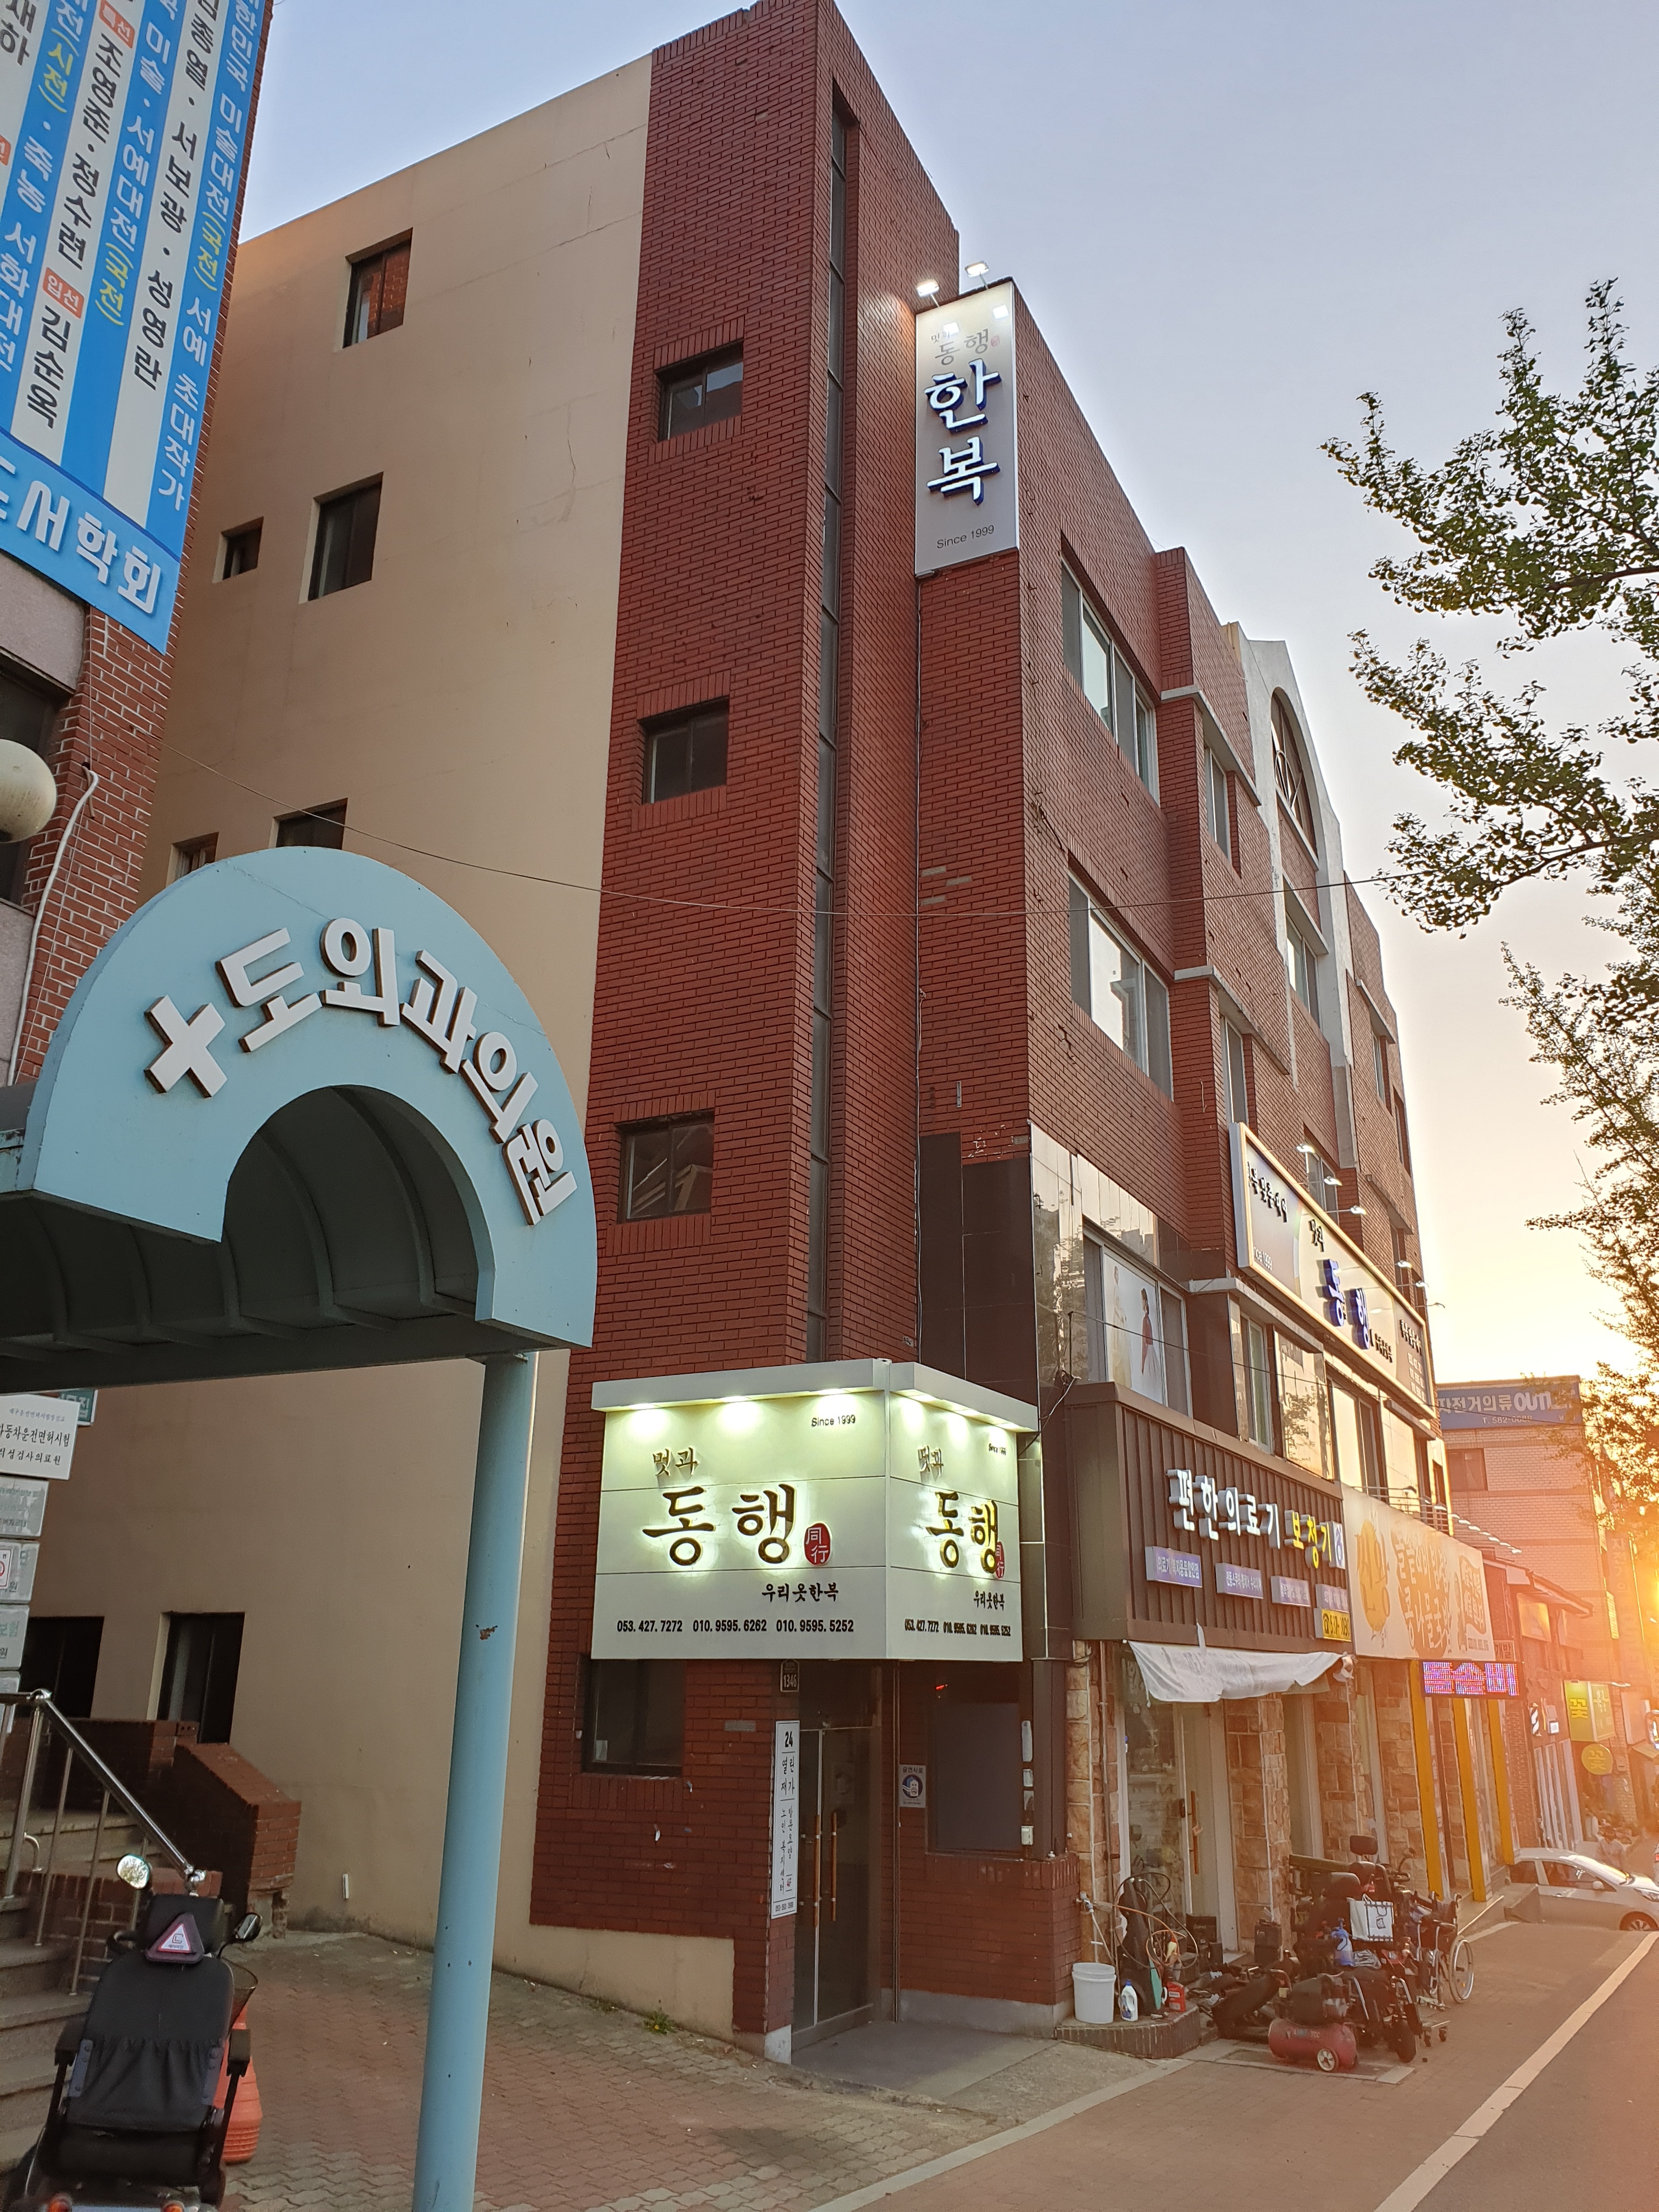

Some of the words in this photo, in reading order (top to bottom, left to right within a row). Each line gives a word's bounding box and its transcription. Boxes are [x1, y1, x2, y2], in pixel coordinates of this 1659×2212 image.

[226, 0, 259, 92] 한민국
[159, 121, 198, 234] 서보광
[48, 274, 79, 313] 입선
[133, 269, 173, 391] 성영란
[26, 305, 71, 429] 김순옥
[934, 328, 989, 366] 동행
[924, 358, 1002, 506] 한복
[936, 534, 967, 549] Since
[970, 525, 995, 540] 1999
[216, 916, 579, 1227] 도외과의원
[1322, 1259, 1370, 1350] 동행
[652, 1446, 700, 1477] 멋과
[811, 1416, 835, 1427] Since
[837, 1414, 856, 1426] 1999
[641, 1482, 797, 1567] 동행
[926, 1490, 998, 1575] 동행
[1169, 1469, 1280, 1550] 편한의료기
[1284, 1509, 1332, 1569] 보청기
[783, 1674, 797, 1688] 1346
[1570, 1698, 1588, 1719] 꽃
[785, 1730, 793, 1748] 24
